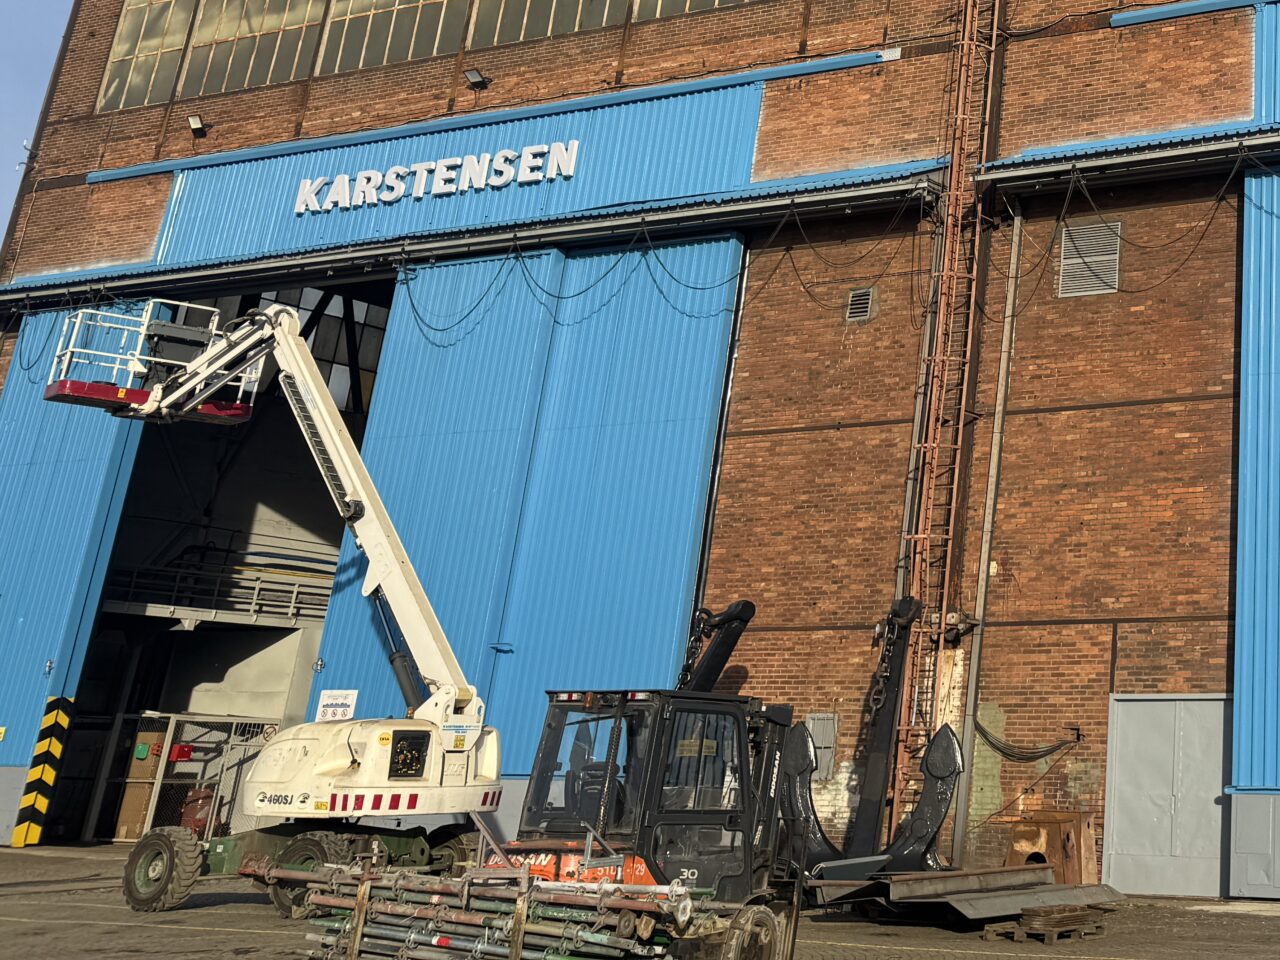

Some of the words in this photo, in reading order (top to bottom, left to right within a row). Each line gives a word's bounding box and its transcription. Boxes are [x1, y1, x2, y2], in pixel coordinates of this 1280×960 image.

[294, 139, 580, 214] KARSTENSEN
[769, 750, 781, 798] DOOSAN
[267, 794, 294, 805] 460SJ
[679, 868, 699, 880] 30
